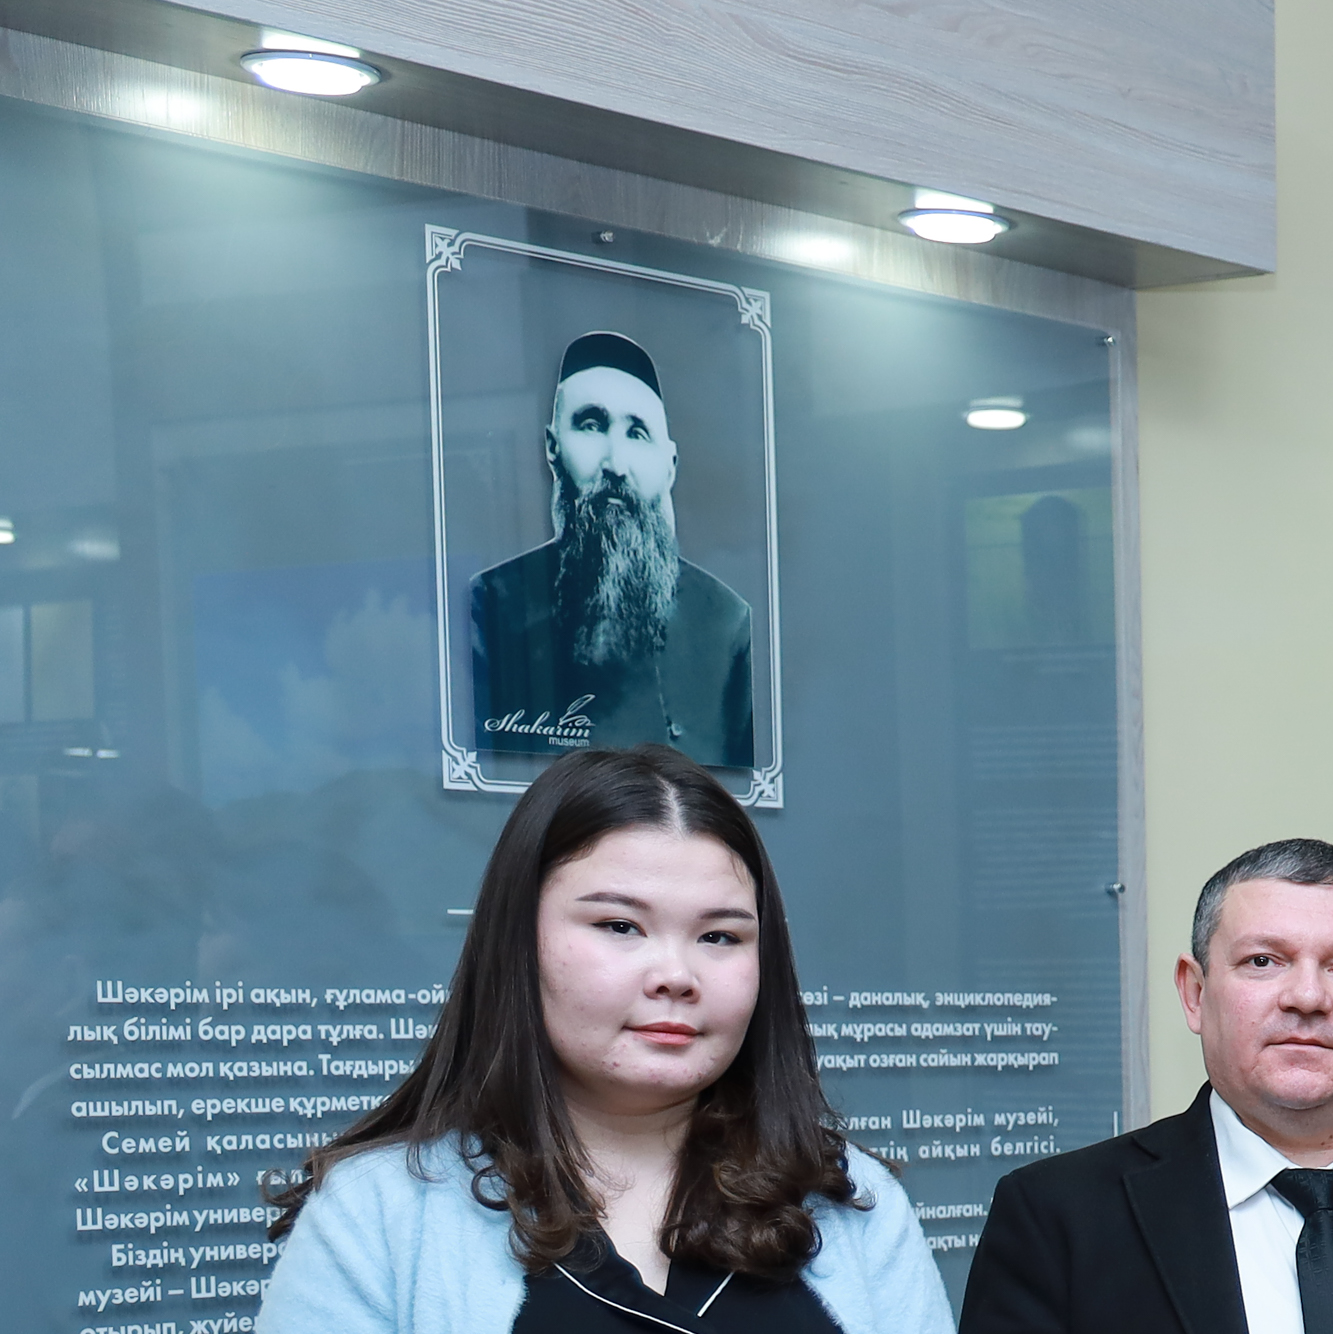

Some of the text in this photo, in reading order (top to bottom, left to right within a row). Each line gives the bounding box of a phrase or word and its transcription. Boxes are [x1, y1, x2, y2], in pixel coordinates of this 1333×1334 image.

[484, 709, 591, 737] Shakarim
[549, 736, 590, 747] museum
[96, 980, 210, 1010] Шәкәрім
[215, 981, 244, 1010] ірі
[250, 988, 317, 1007] ақын,
[849, 991, 930, 1008] даналық,
[935, 991, 1058, 1008] энциклопедия-
[67, 1025, 118, 1045] лық
[123, 1017, 191, 1041] білімі
[198, 1016, 246, 1046] бар
[251, 1024, 312, 1046] дара
[317, 1024, 385, 1046] тұлға.
[841, 1022, 907, 1042] мұрасы
[911, 1022, 981, 1039] адамзат
[984, 1017, 1021, 1041] үшін
[1025, 1022, 1058, 1041] тау-
[69, 1062, 162, 1079] сылмас
[166, 1062, 214, 1078] мол
[219, 1060, 315, 1080] қазына.
[869, 1053, 916, 1068] озған
[919, 1049, 971, 1067] сайын
[974, 1052, 1058, 1070] жарқырап
[71, 1099, 185, 1119] ашылып,
[191, 1097, 285, 1121] ерекше
[102, 1131, 190, 1154] Семей
[902, 1109, 985, 1132] Шәкәрім
[993, 1106, 1059, 1130] музейі,
[75, 1166, 240, 1195] «Шәкәрім»
[919, 1141, 980, 1159] айқын
[991, 1136, 1061, 1155] белгісі.
[76, 1204, 190, 1234] Шәкәрім
[112, 1241, 186, 1268] Біздің
[78, 1278, 162, 1312] музейі
